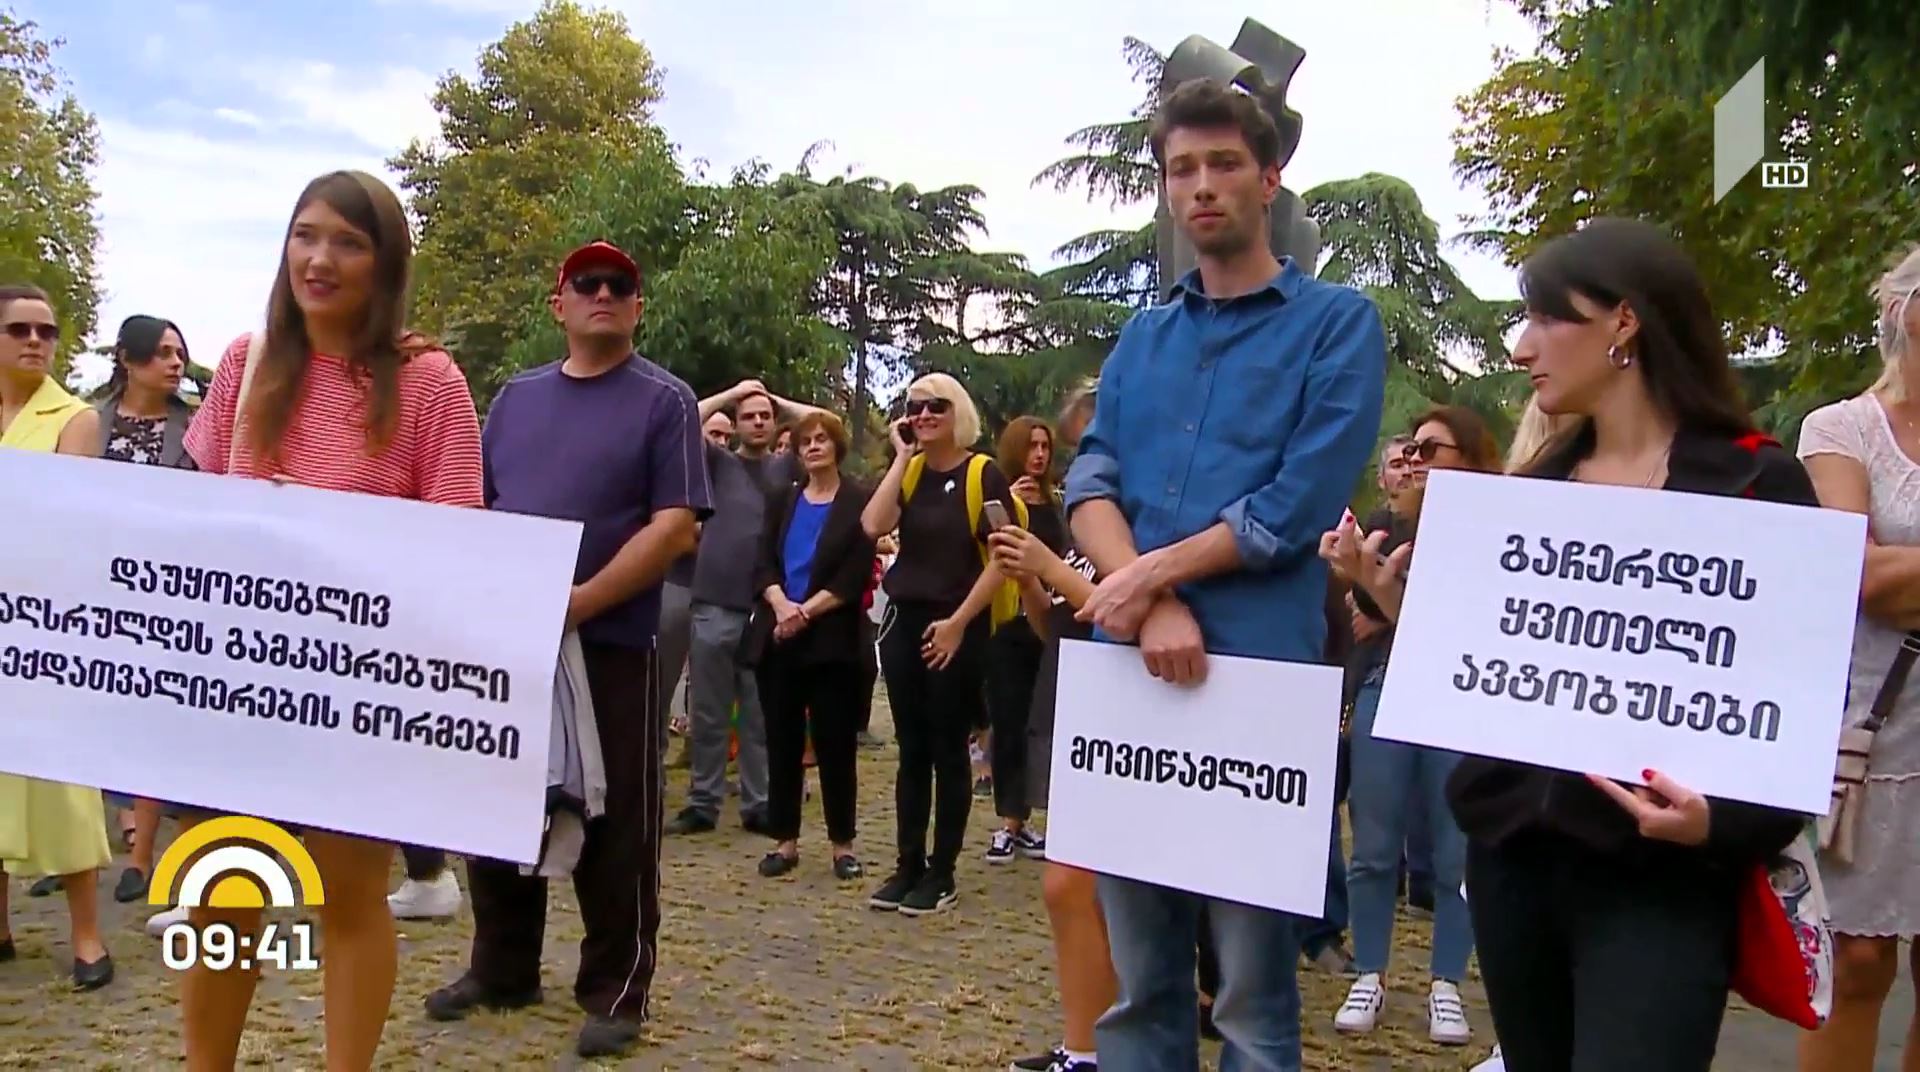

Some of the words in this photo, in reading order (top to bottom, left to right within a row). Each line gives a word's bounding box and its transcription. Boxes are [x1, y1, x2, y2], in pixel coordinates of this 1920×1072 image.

[109, 556, 391, 629] დაუყოვნებლივ
[1499, 534, 1757, 601] გაჩერდეს
[224, 626, 511, 704] გამკაცრებული
[1499, 597, 1737, 668] ყვითელი
[0, 645, 341, 730] ექდათვალიერების
[352, 700, 521, 761] ნორმები
[1452, 653, 1781, 742] ავტობუსები
[1070, 735, 1308, 808] მოვიწამლეთ
